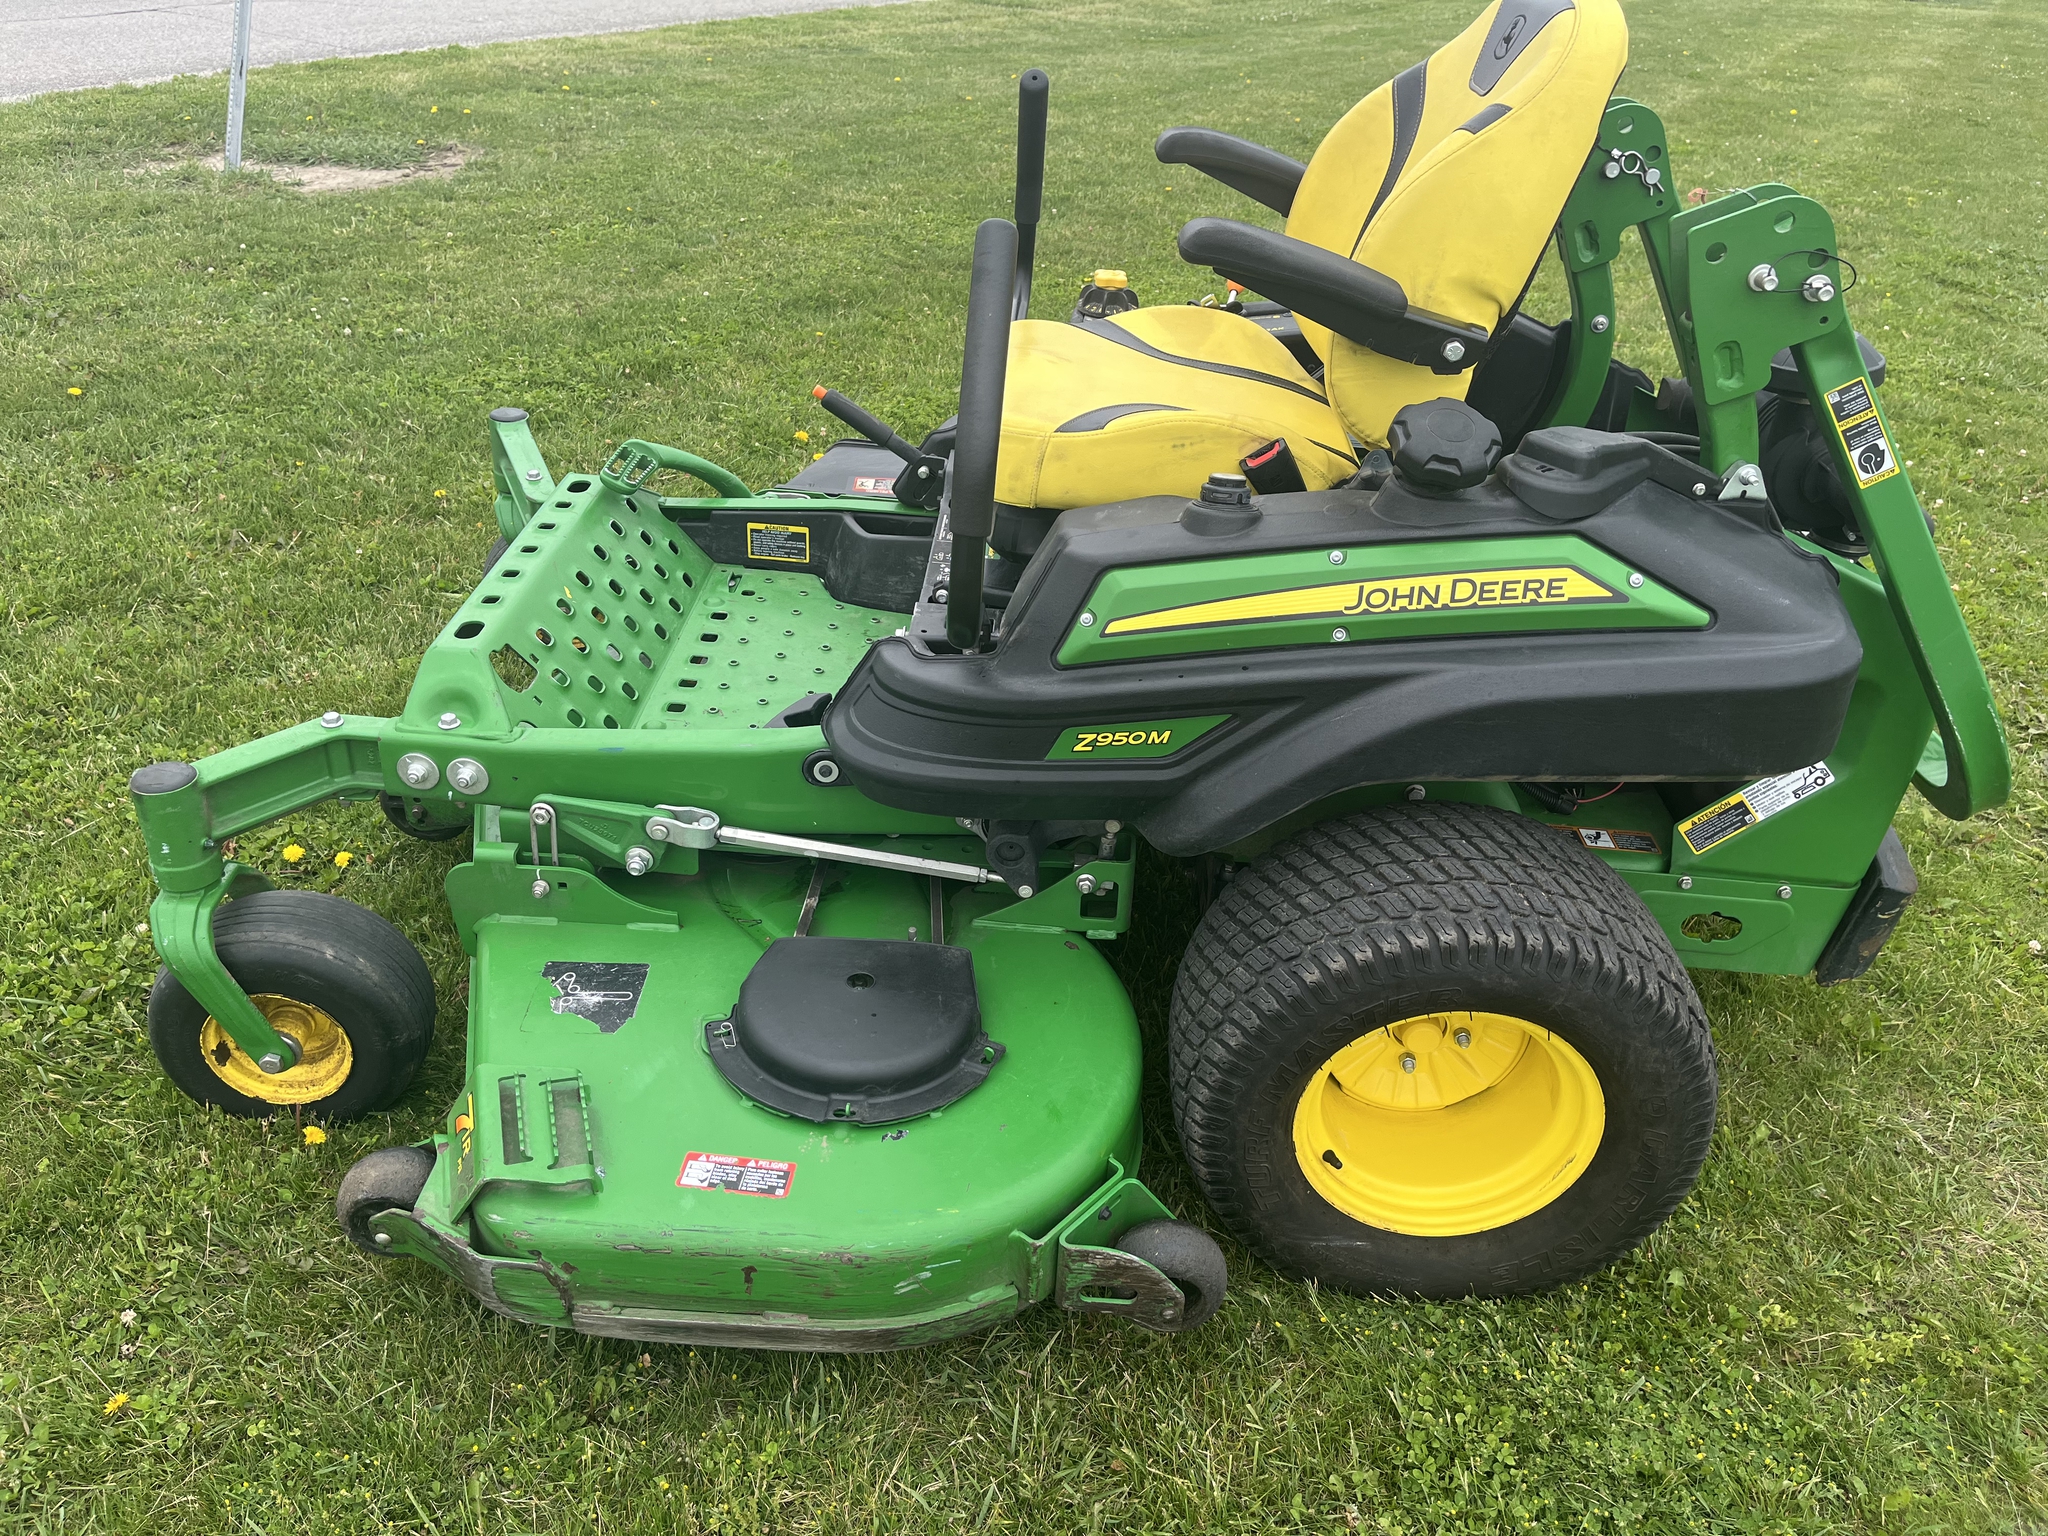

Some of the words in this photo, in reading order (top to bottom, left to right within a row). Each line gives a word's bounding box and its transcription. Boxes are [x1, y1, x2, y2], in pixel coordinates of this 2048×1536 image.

[1862, 470, 1891, 487] CAUTION
[1344, 585, 1440, 610] JOHN
[1450, 578, 1568, 603] DEERE
[1072, 730, 1172, 752] Z950M
[1697, 800, 1731, 823] ATENCIÓN
[1259, 987, 1463, 1105] MASTER
[758, 1161, 788, 1170] PELIGRO
[1244, 1109, 1281, 1212] TURF
[1489, 1129, 1669, 1286] CARLISLE
